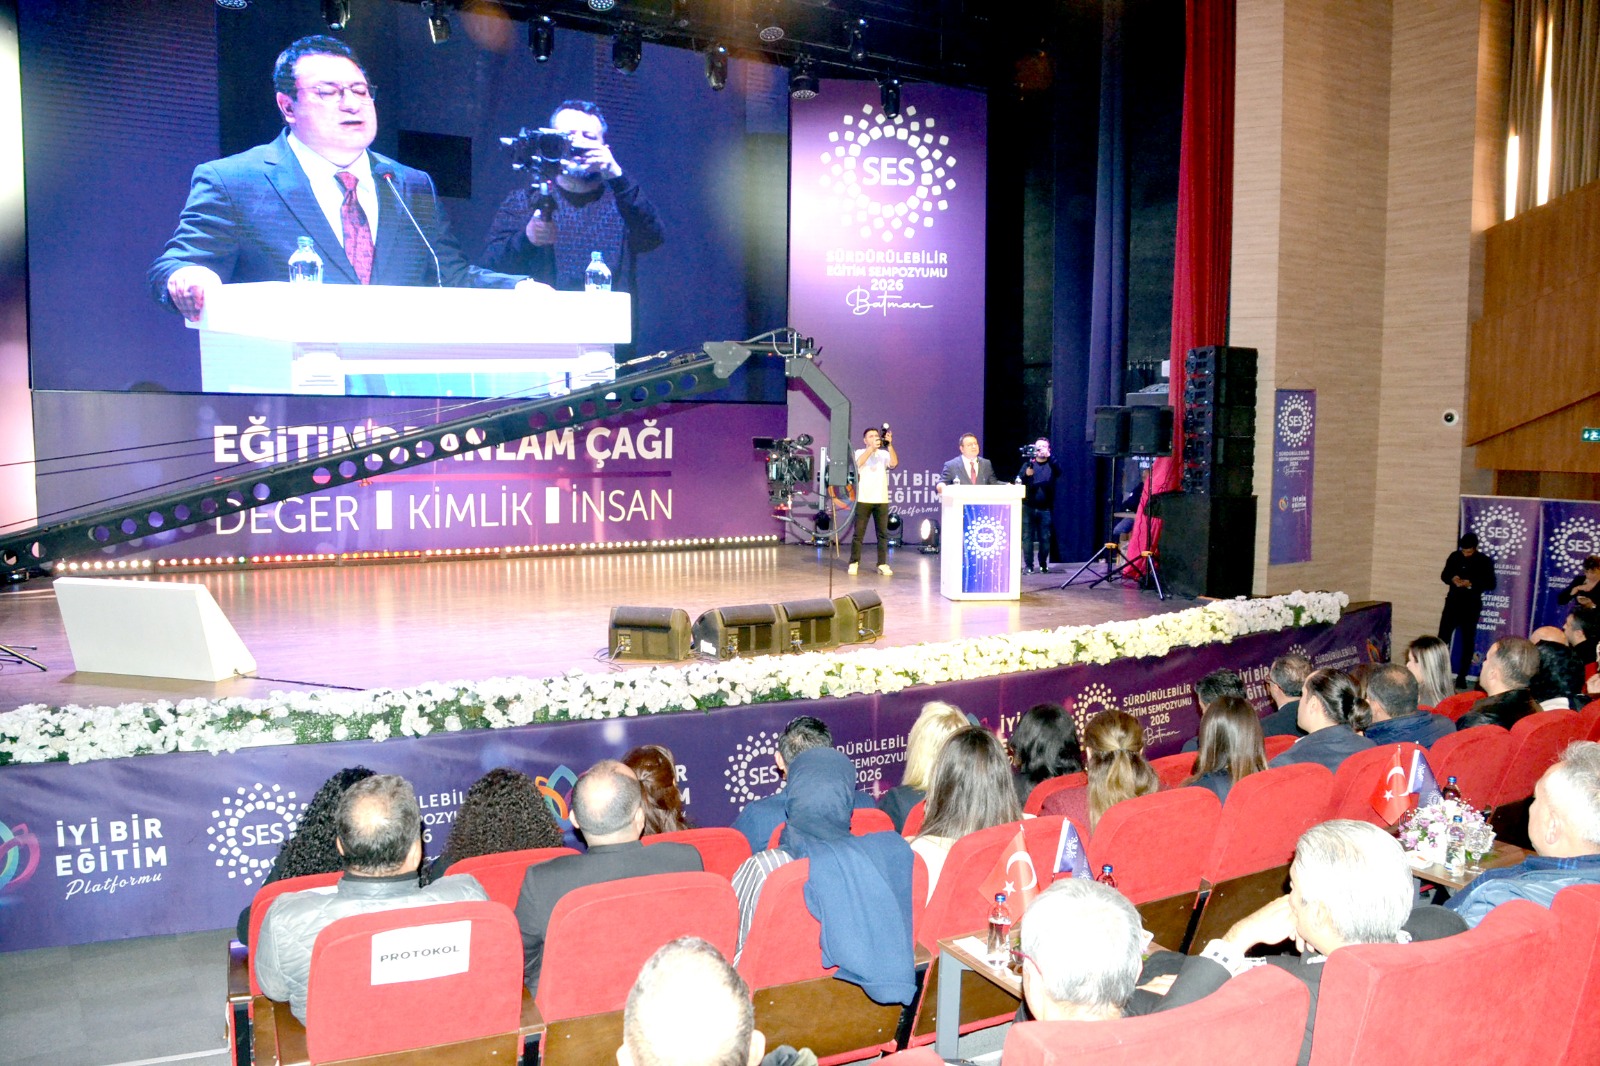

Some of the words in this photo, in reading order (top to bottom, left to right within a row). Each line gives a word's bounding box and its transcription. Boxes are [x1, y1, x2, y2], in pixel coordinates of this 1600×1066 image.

[862, 157, 915, 186] SES
[825, 249, 948, 264] SÜRDÜRÜLEBİLİR
[826, 264, 866, 277] EĞİTİM
[868, 266, 948, 278] SEMPOZYUMU
[871, 278, 904, 291] 2026
[845, 285, 934, 317] Batman
[1288, 415, 1302, 426] SES
[586, 419, 673, 468] ÇAĞI
[409, 485, 533, 530] KİMLİK
[572, 484, 673, 524] İNSAN
[1487, 527, 1510, 539] SES
[1567, 540, 1592, 552] SES
[1122, 683, 1192, 707] SÜRDÜRÜLEBİLİR
[1148, 697, 1192, 715] SEMPOZYUMU
[1150, 712, 1170, 726] 2026
[749, 764, 780, 786] SES
[56, 817, 99, 848] İYİ
[109, 813, 163, 843] BİR
[241, 822, 285, 847] SES
[55, 842, 168, 877] EĞİTİM
[65, 873, 162, 900] Platformu
[380, 945, 461, 962] PROTOKOL
